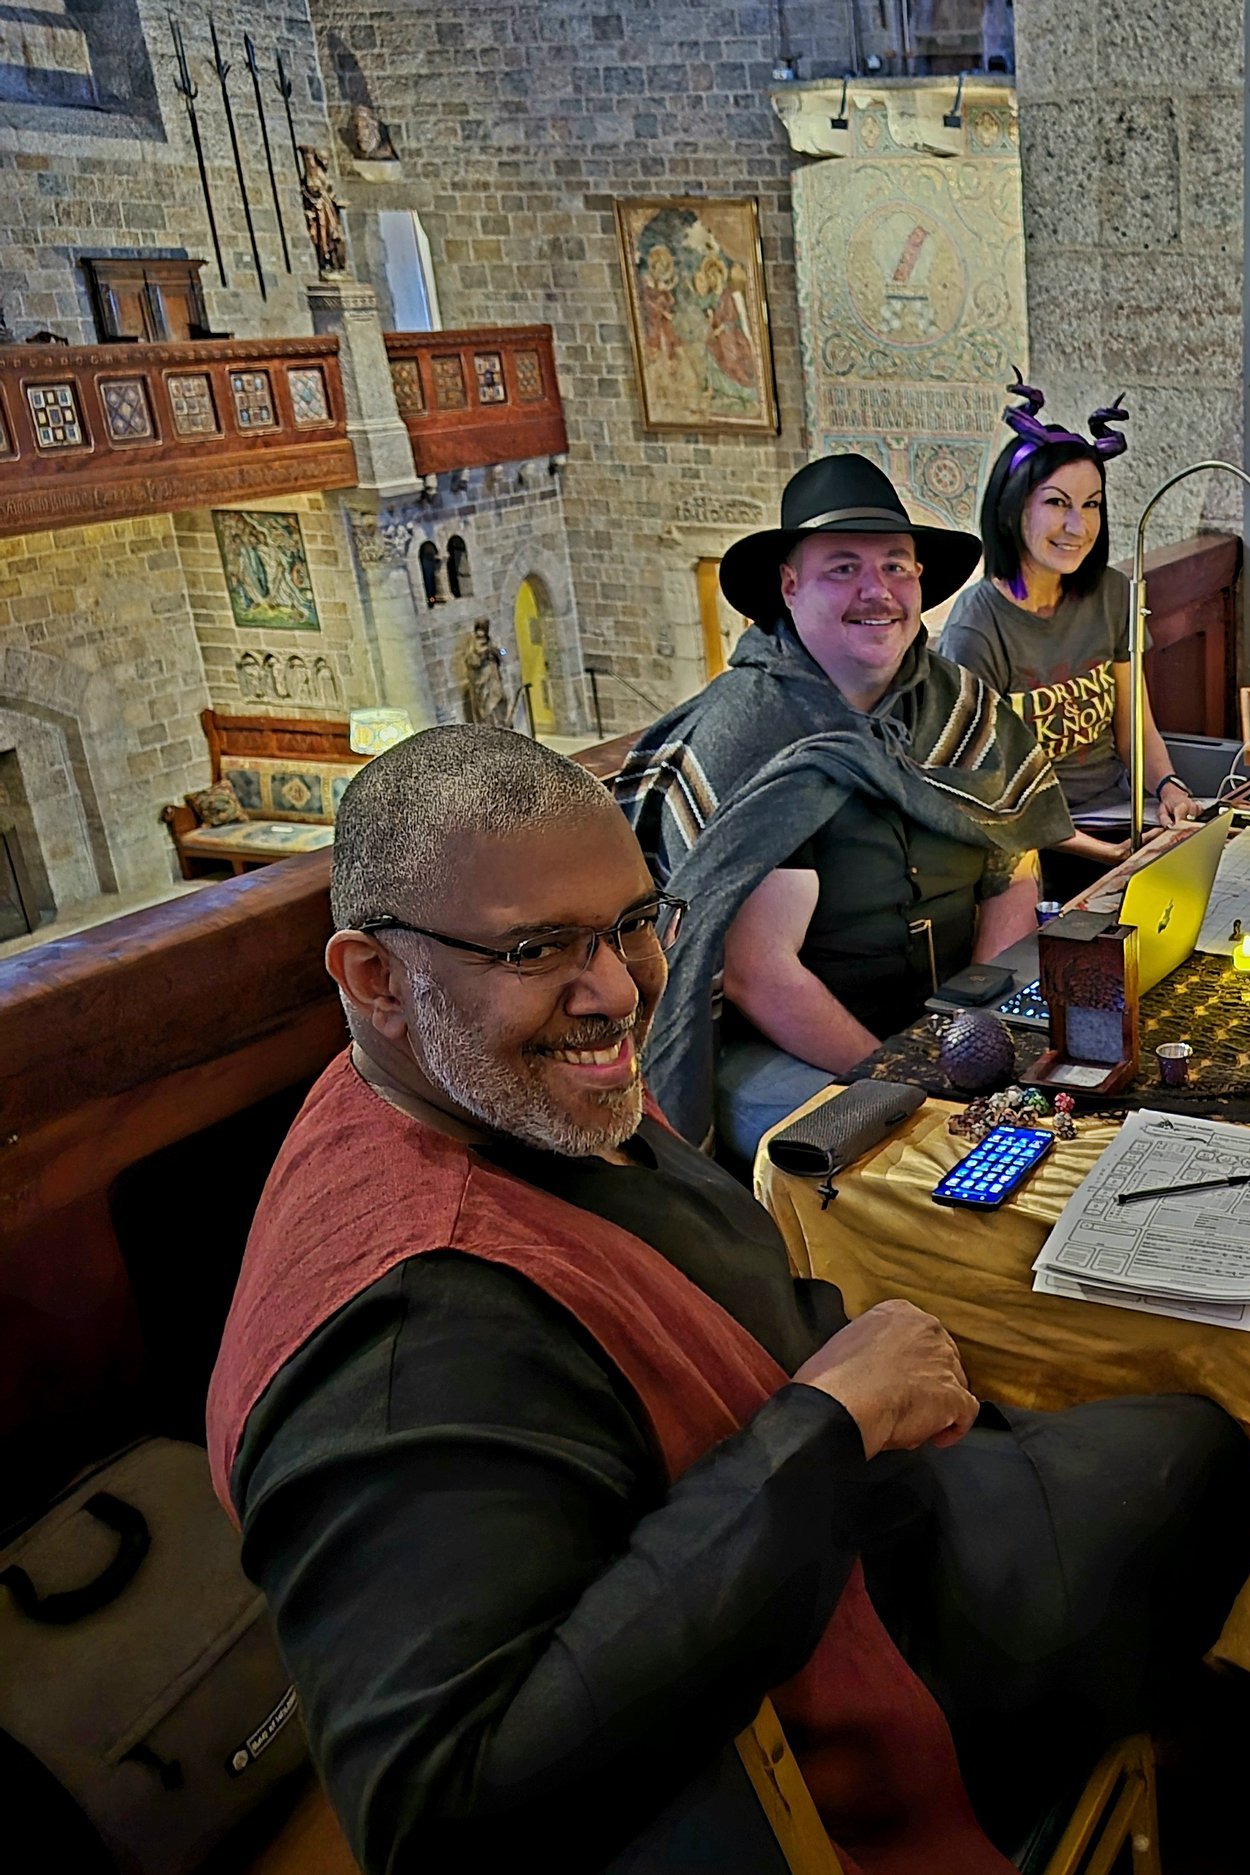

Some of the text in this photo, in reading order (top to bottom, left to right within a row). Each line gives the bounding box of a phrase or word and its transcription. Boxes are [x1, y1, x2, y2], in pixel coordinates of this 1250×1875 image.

[1007, 660, 1116, 720] I DRINK
[1034, 684, 1116, 742] KNOW
[1063, 698, 1081, 717] &
